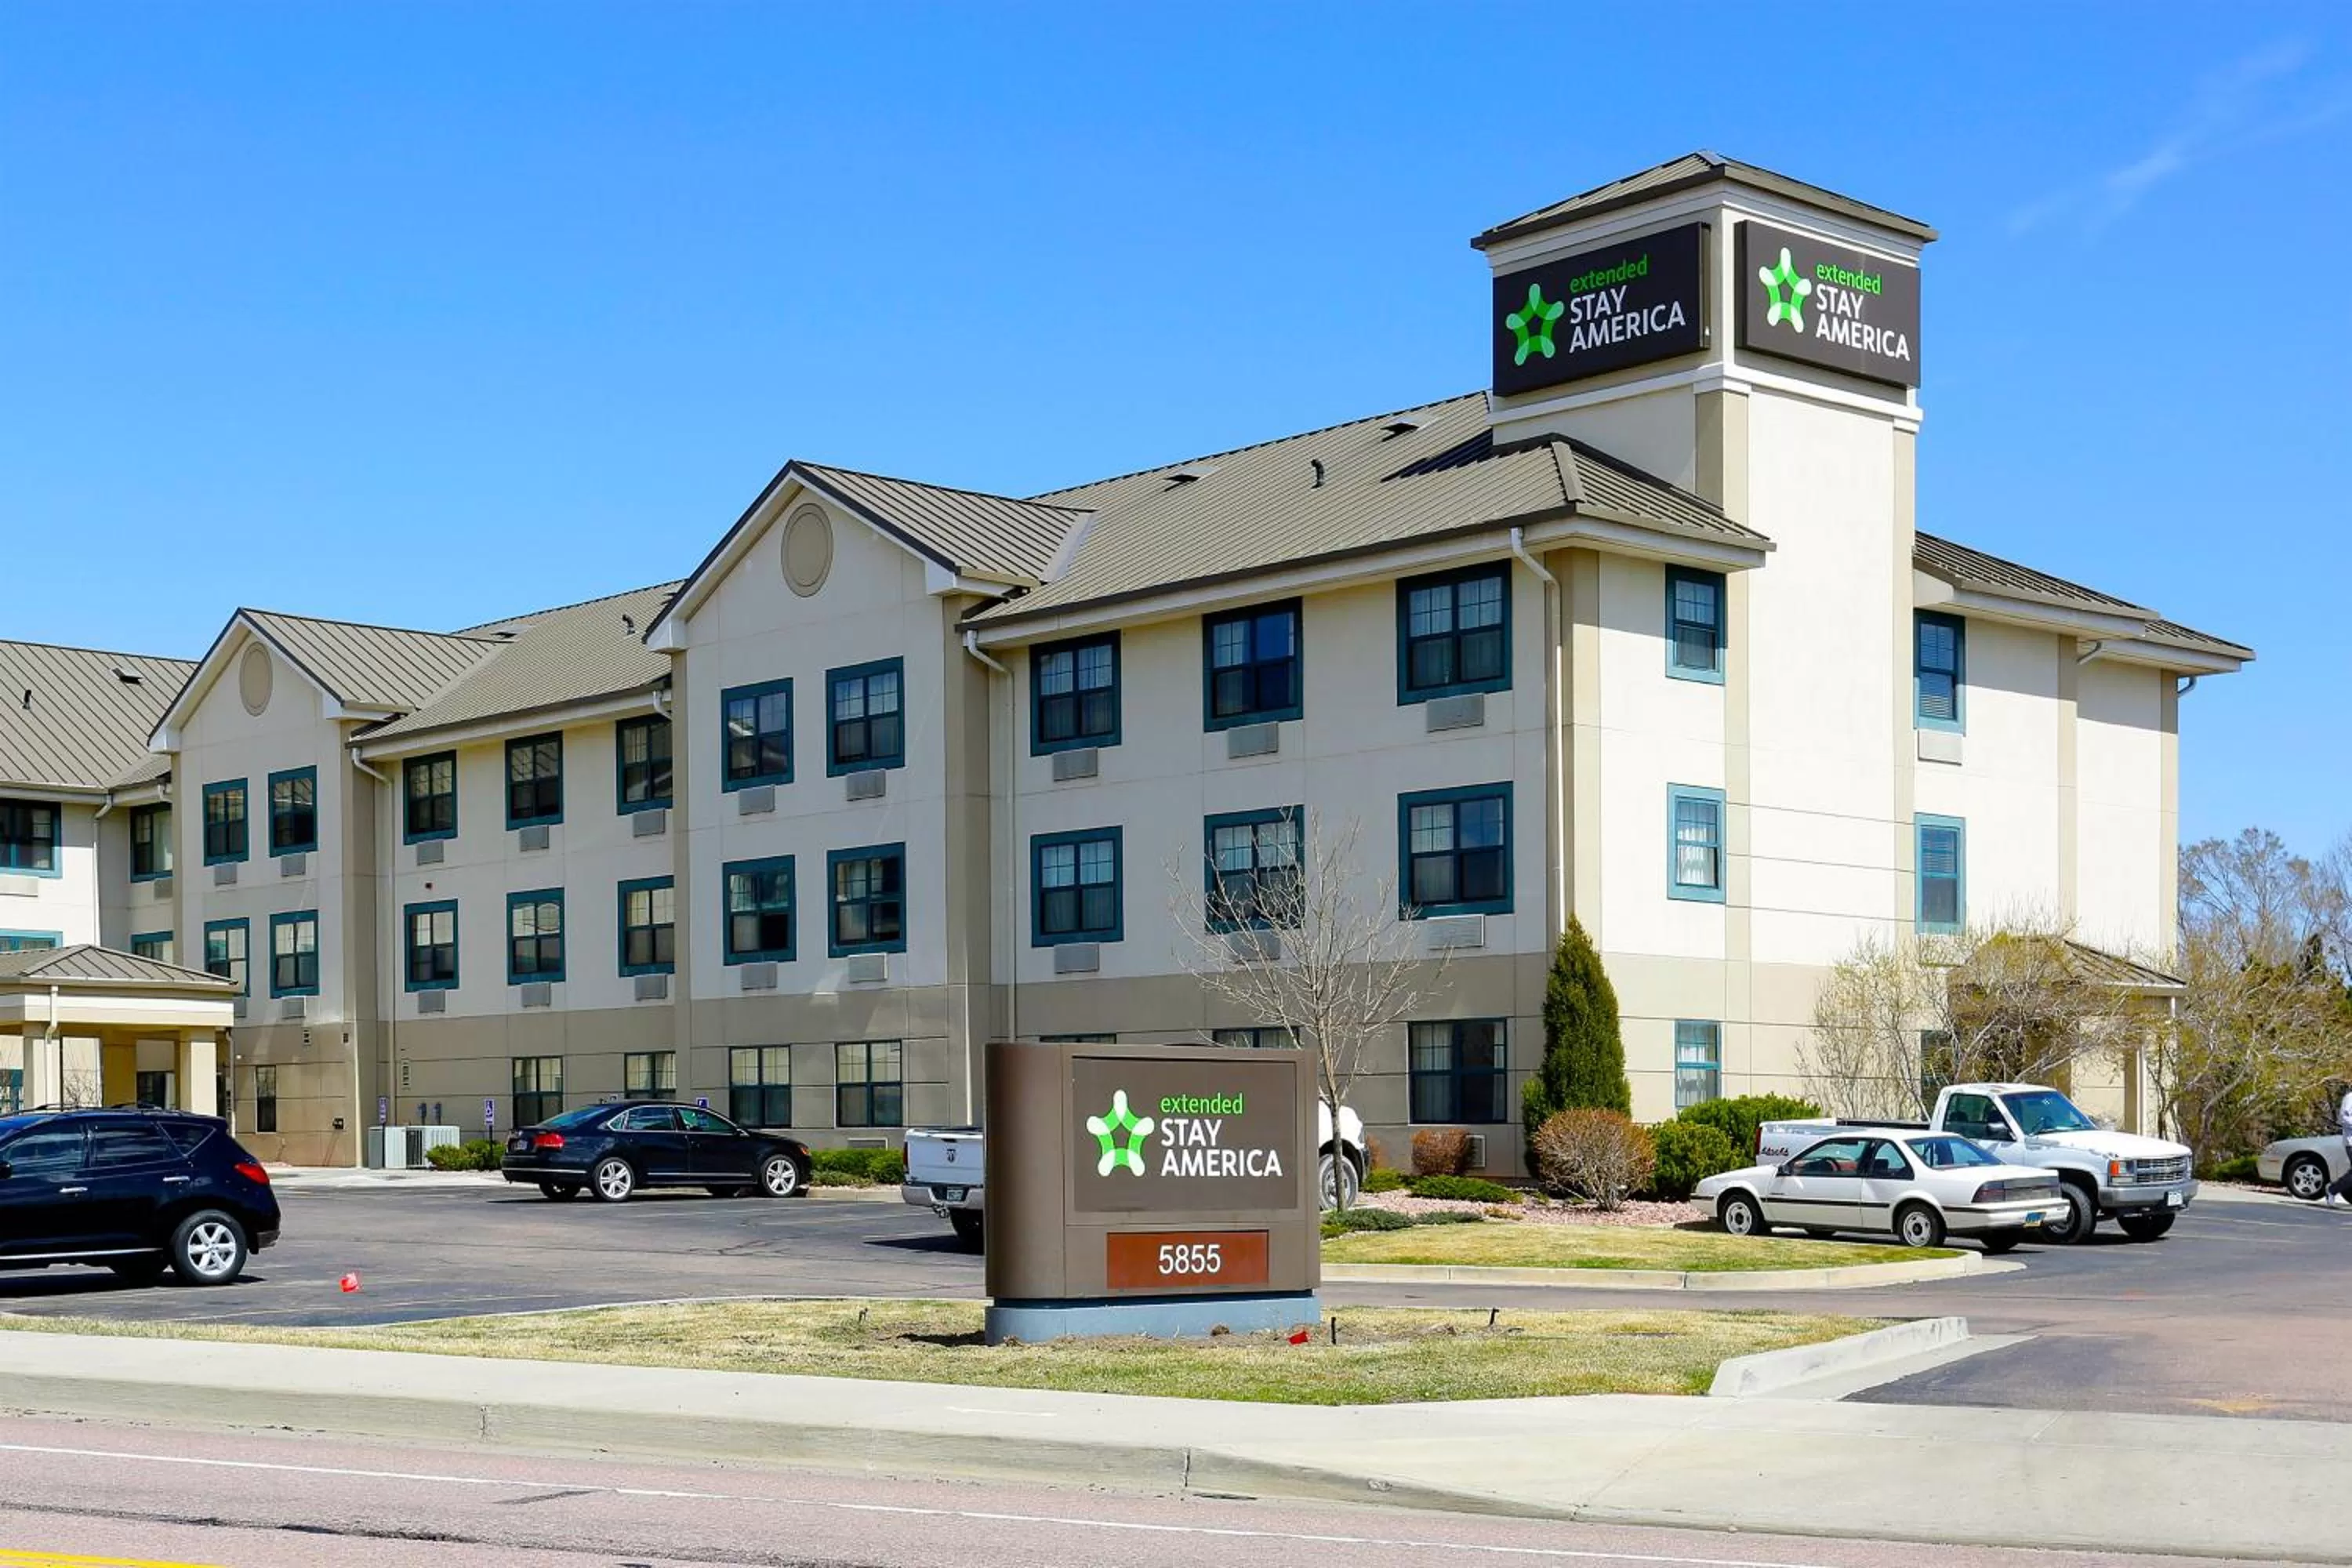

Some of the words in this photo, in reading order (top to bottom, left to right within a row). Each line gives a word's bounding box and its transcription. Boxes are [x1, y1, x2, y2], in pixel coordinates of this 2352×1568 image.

[1570, 253, 1648, 293] extended
[1816, 263, 1882, 295] extended
[1570, 285, 1628, 325] STAY
[1816, 283, 1864, 320] STAY
[1569, 300, 1686, 354] AMERICA
[1815, 313, 1911, 361] AMERICA
[1160, 1092, 1243, 1115] extended
[1160, 1118, 1222, 1147] STAY
[1160, 1149, 1283, 1177] AMERICA
[1158, 1244, 1221, 1275] 5855
